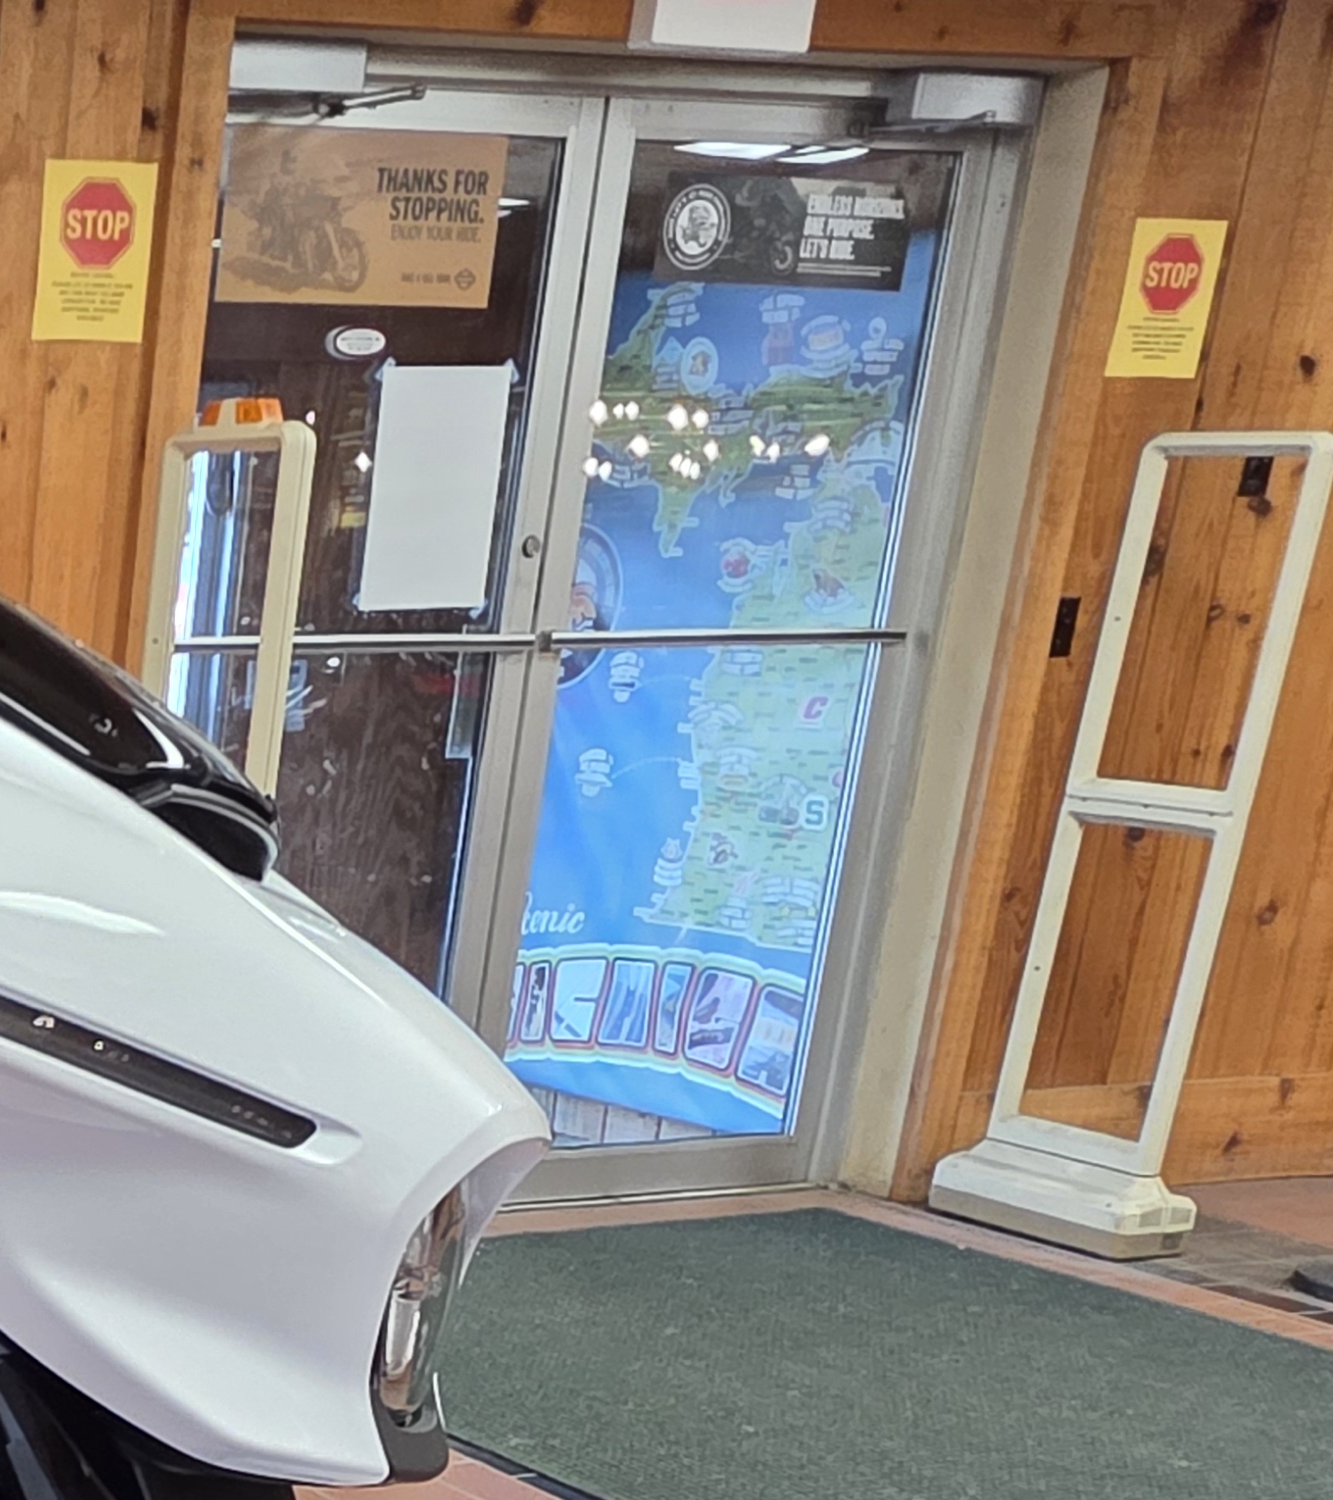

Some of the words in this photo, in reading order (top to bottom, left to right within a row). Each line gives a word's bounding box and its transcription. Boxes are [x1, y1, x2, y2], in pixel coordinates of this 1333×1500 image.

[377, 167, 448, 194] THANKS
[453, 168, 490, 196] FOR
[389, 196, 484, 224] STOPPING.
[66, 208, 130, 241] STOP
[1145, 261, 1199, 289] STOP
